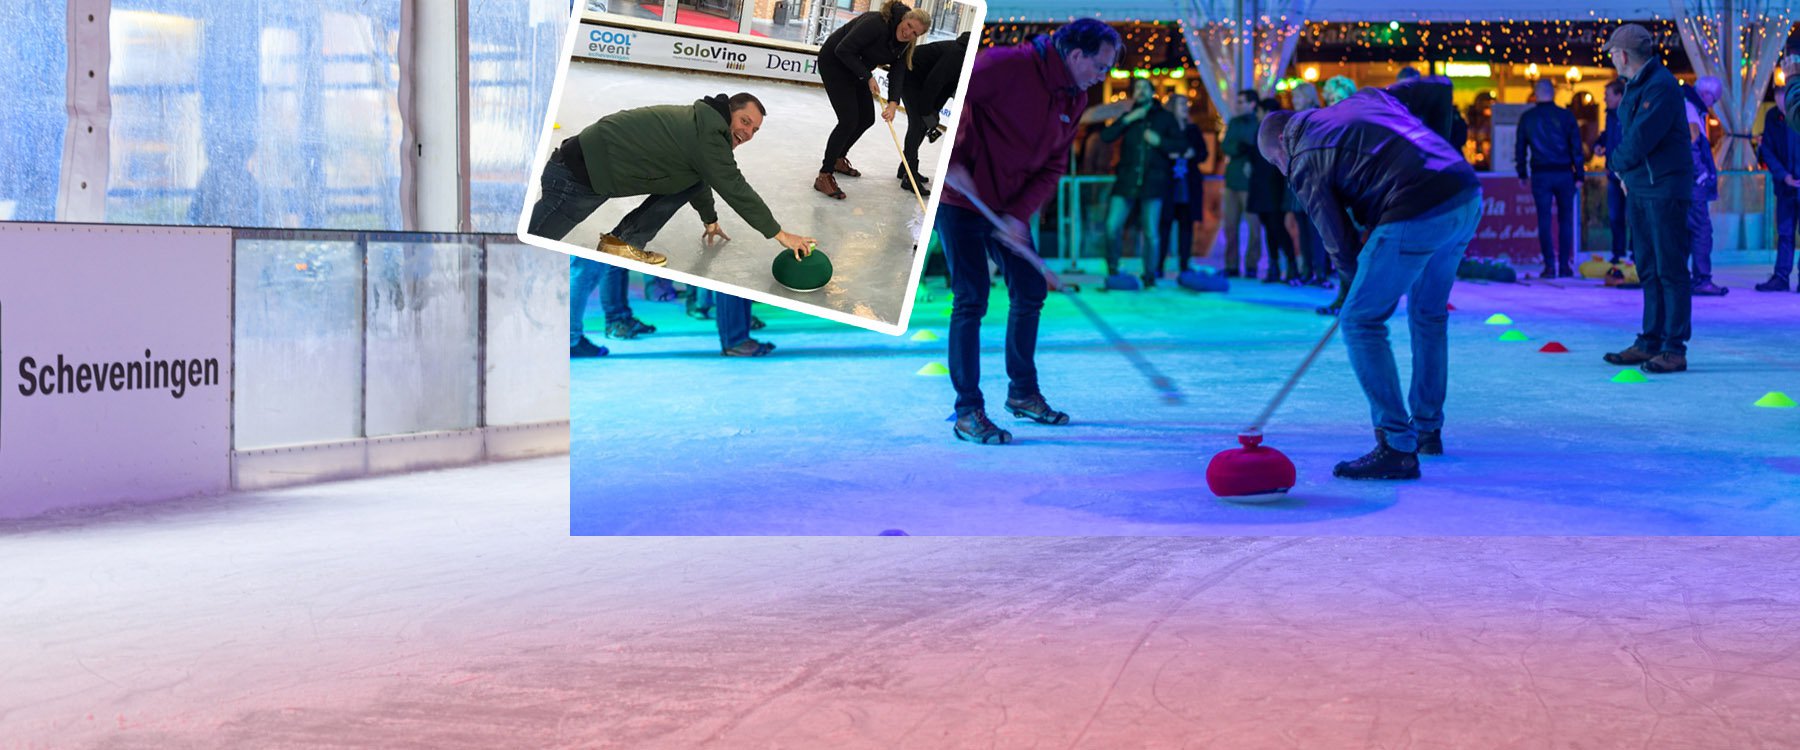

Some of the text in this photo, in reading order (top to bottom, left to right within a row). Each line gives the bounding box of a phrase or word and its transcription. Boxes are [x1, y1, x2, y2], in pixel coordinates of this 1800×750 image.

[590, 29, 631, 46] COOL
[588, 42, 631, 56] event
[672, 42, 748, 63] SoloVino
[766, 53, 820, 75] Den H
[18, 348, 219, 399] Scheveningen
